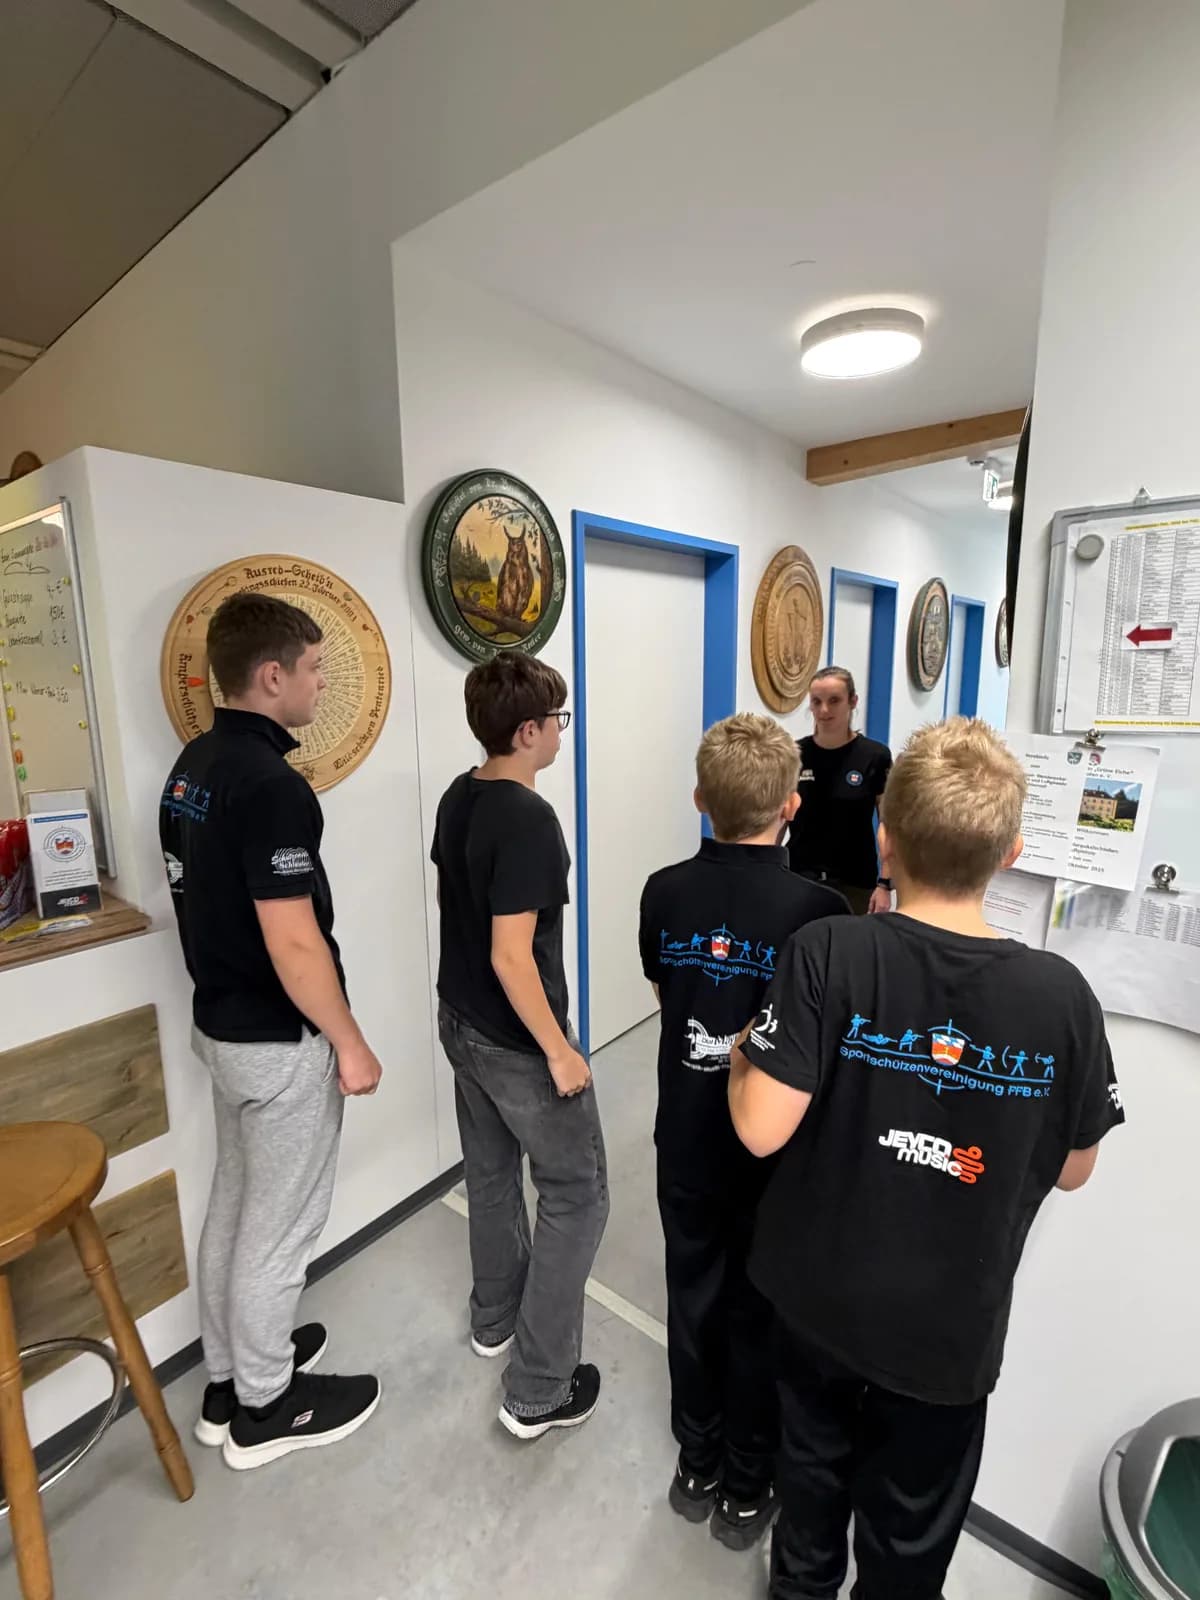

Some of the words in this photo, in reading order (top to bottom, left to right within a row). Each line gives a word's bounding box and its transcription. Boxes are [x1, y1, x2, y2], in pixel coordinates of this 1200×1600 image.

[839, 1046, 1005, 1096] Sportschützenvereinigung
[1007, 1085, 1032, 1098] FFB
[878, 1129, 953, 1157] JEYCO
[897, 1148, 963, 1176] music
